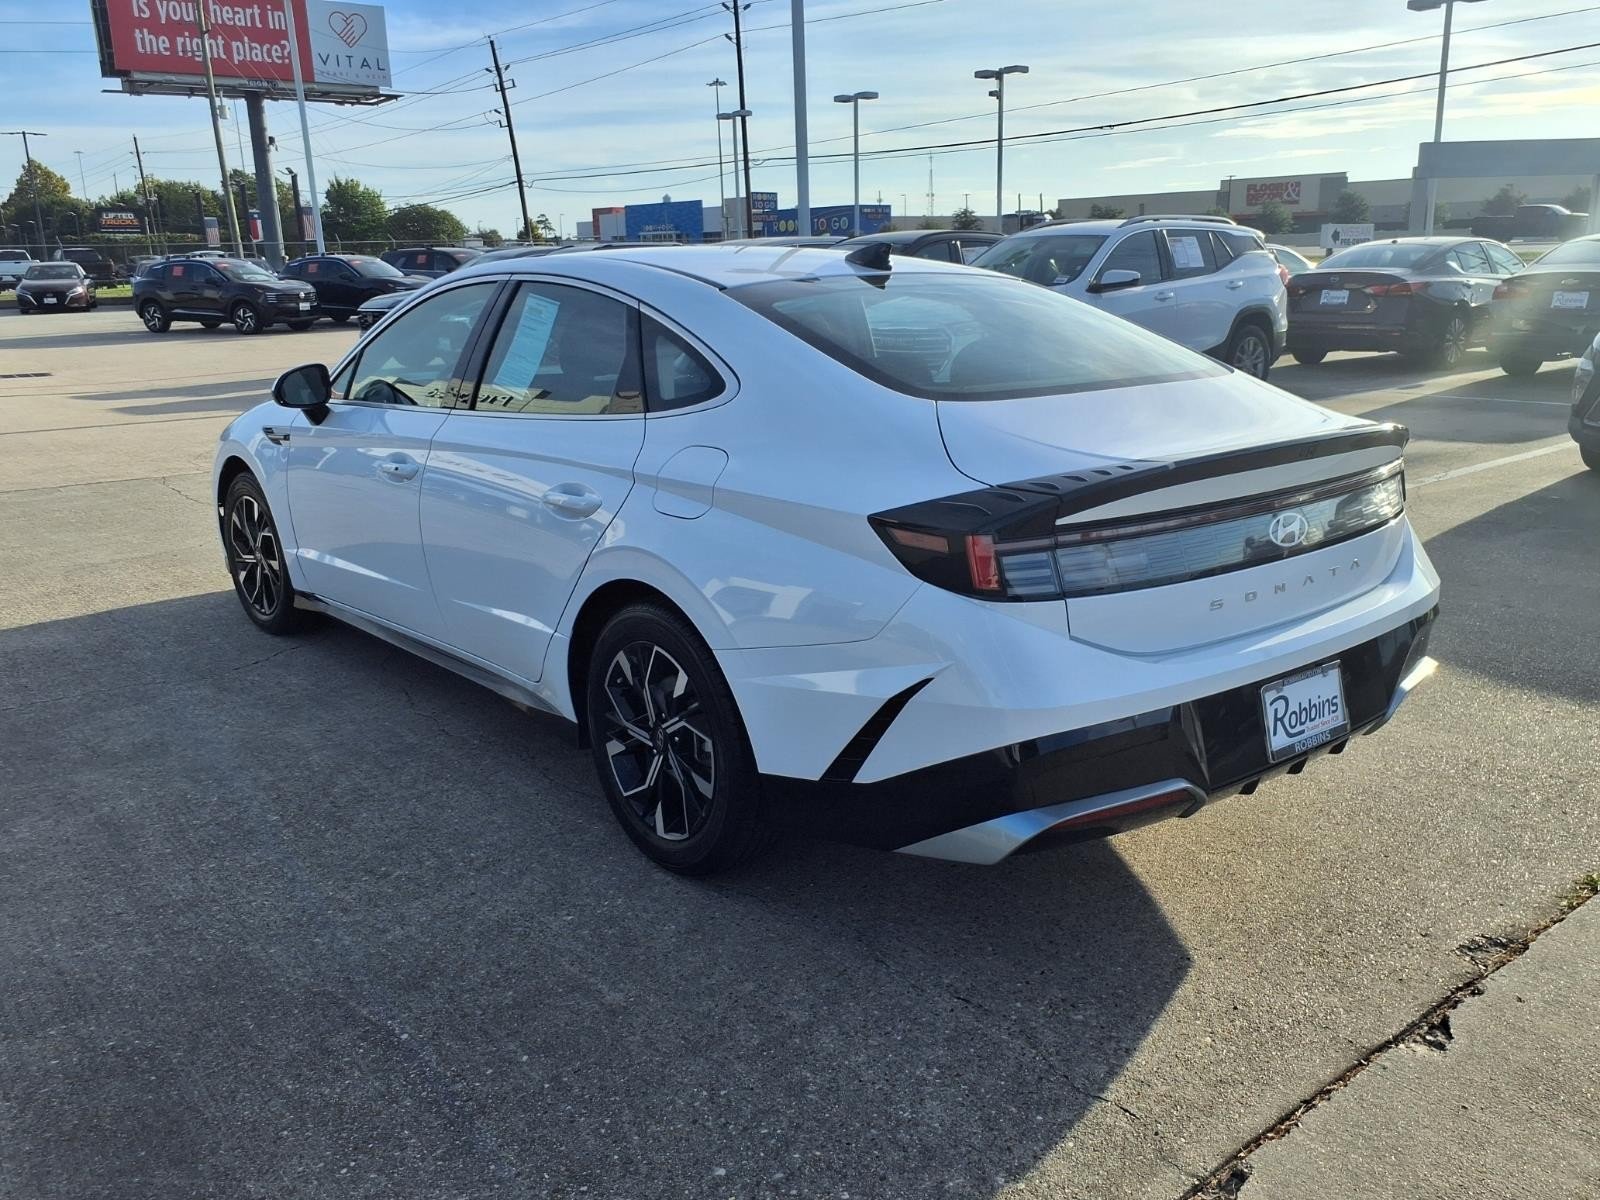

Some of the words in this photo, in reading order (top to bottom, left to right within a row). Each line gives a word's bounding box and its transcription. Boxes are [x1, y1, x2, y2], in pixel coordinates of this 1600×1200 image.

[208, 0, 262, 28] heart
[266, 5, 287, 30] in
[134, 28, 170, 56] the
[232, 36, 291, 64] place?
[318, 52, 386, 71] VITAL
[752, 192, 777, 200] ROOMS
[754, 201, 764, 209] TO
[765, 201, 775, 209] GO
[814, 218, 827, 231] TO
[831, 217, 849, 230] GO
[1209, 558, 1361, 611] SONATA
[1269, 695, 1339, 738] Robbins
[1295, 731, 1331, 753] ROBBINS
